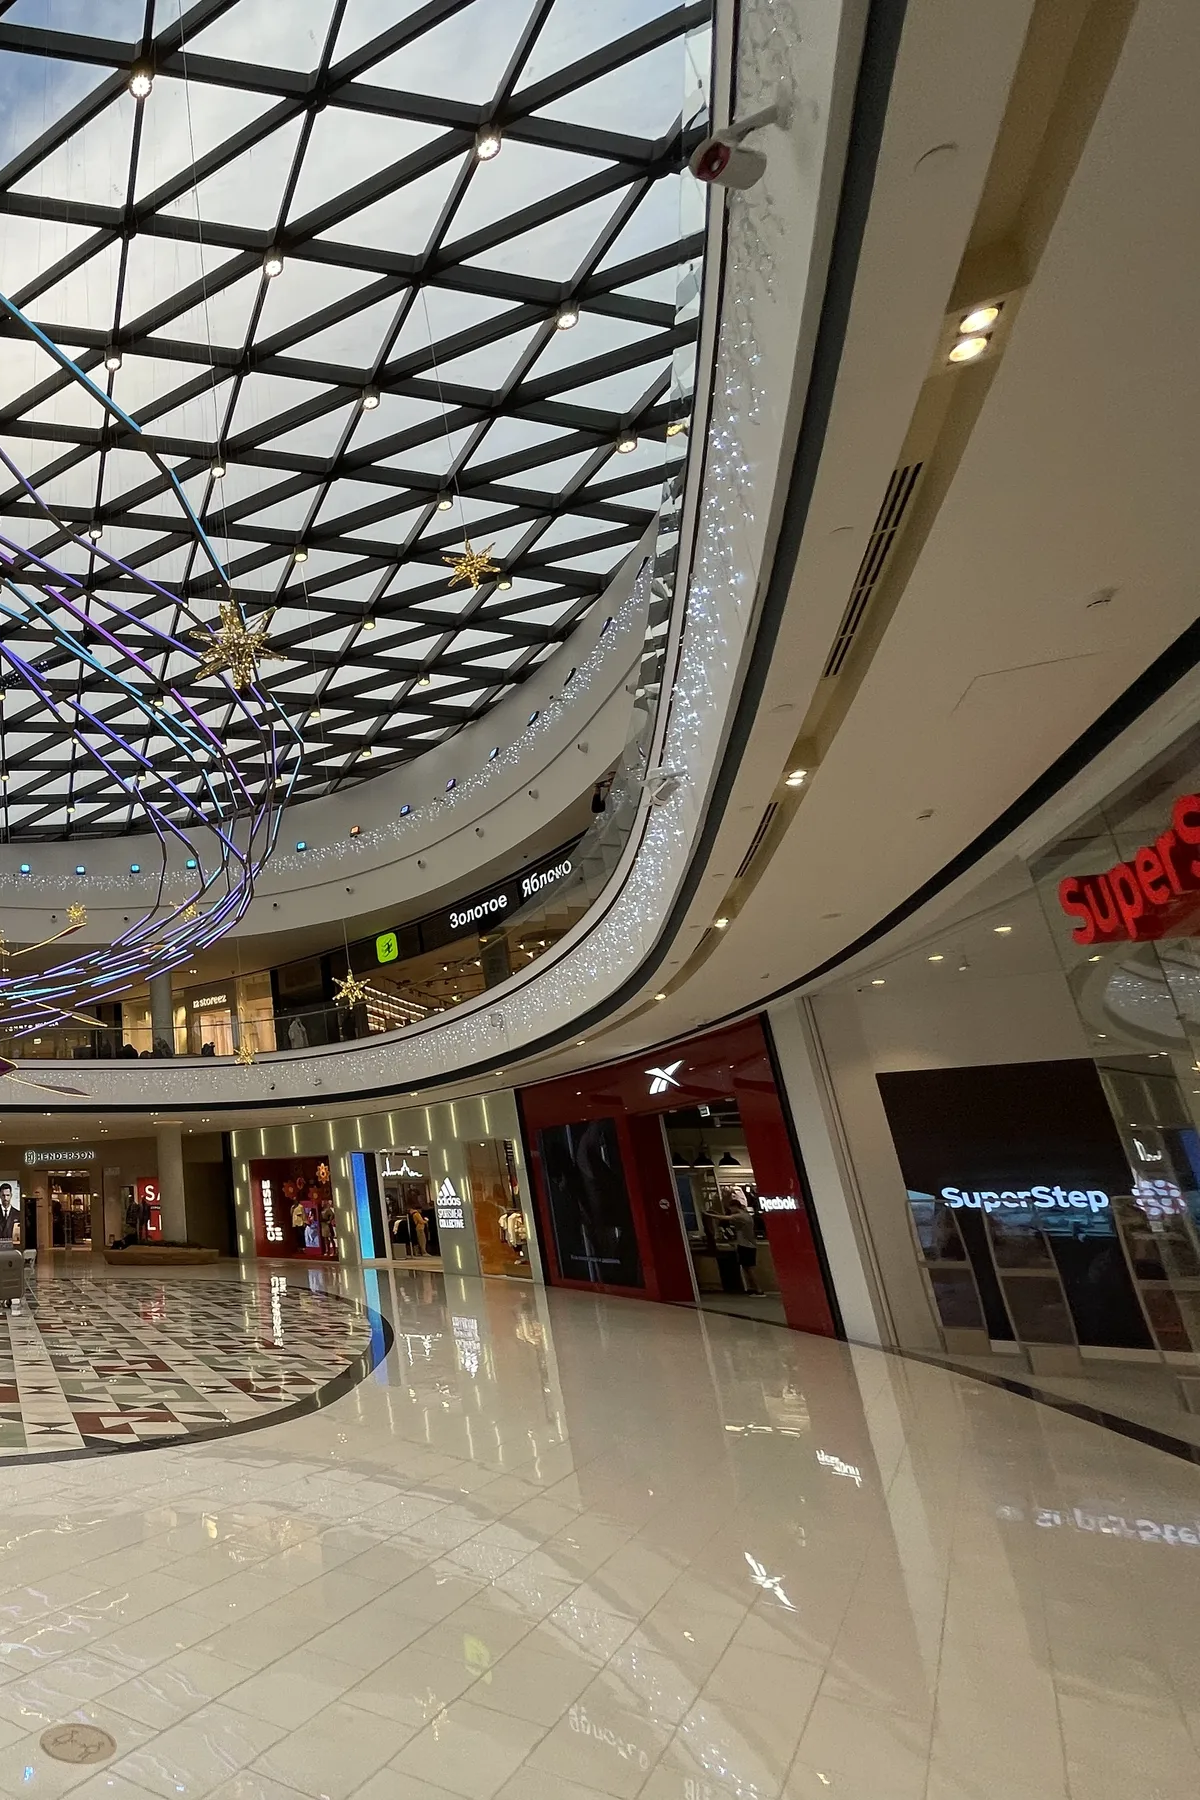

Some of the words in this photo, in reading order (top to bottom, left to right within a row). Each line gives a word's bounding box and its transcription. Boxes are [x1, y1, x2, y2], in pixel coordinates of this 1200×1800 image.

[1058, 794, 1200, 945] SuperS
[449, 894, 508, 929] Золотое
[521, 859, 573, 898] Яблоко
[36, 1151, 95, 1161] HENDERSON
[261, 1179, 276, 1242] CHINESE
[437, 1195, 461, 1206] adidas
[758, 1196, 797, 1212] Reebok
[941, 1185, 1110, 1213] SuperStep
